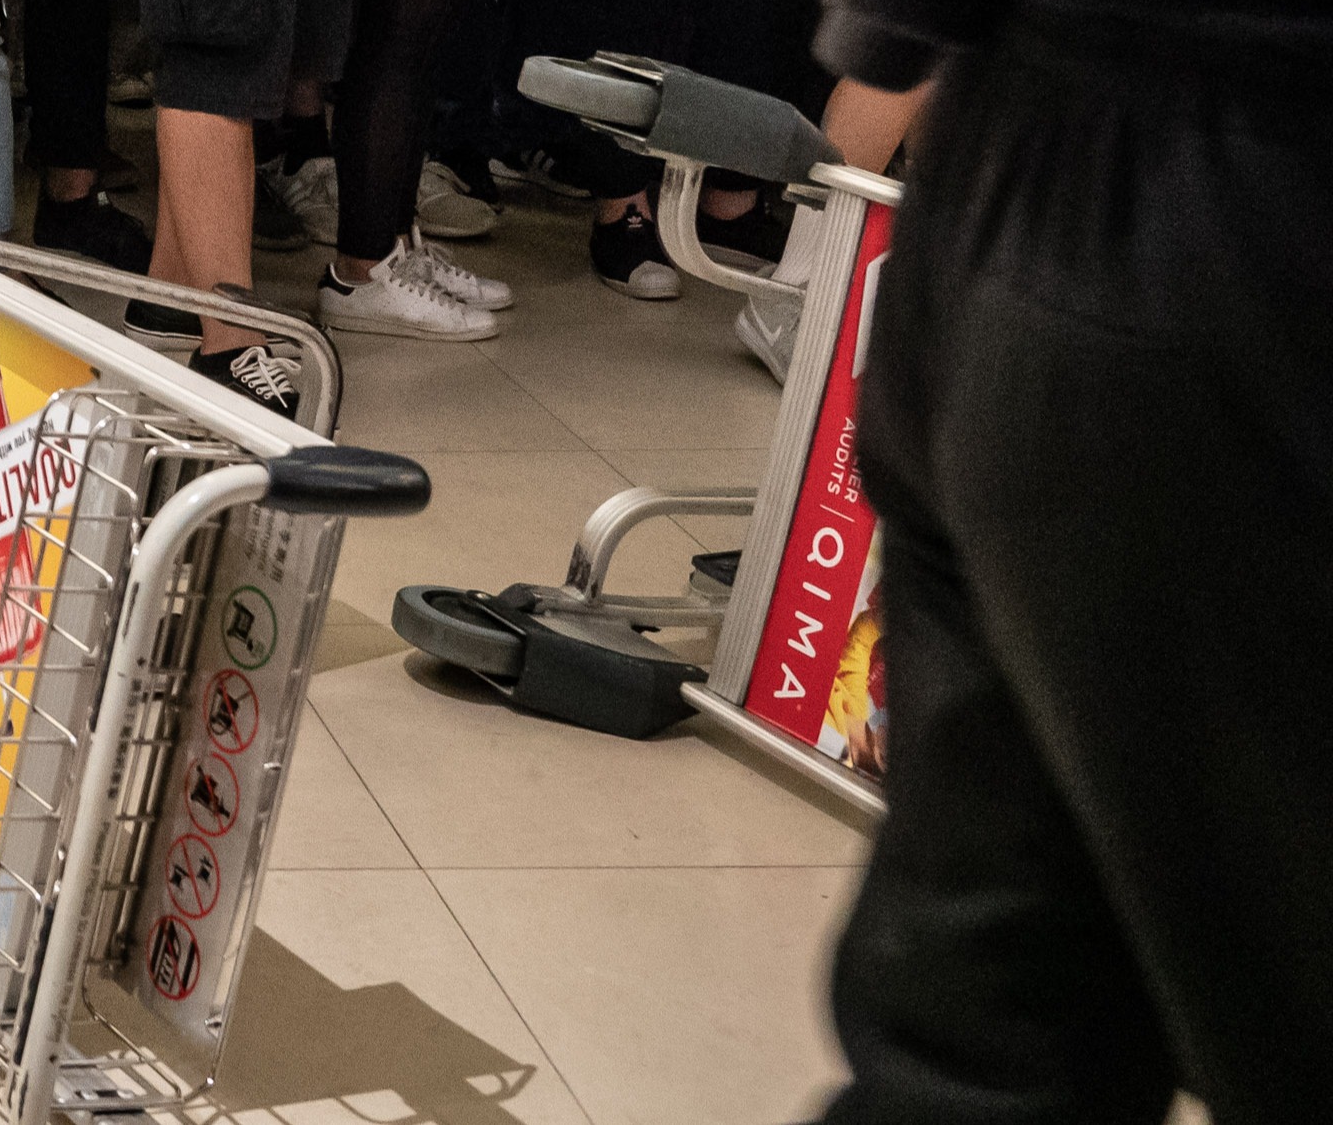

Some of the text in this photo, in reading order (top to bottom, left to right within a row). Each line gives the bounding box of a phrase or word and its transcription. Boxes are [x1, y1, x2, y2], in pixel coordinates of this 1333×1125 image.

[13, 430, 27, 448] you
[827, 416, 857, 496] AUDITS
[773, 526, 845, 699] QIMA
